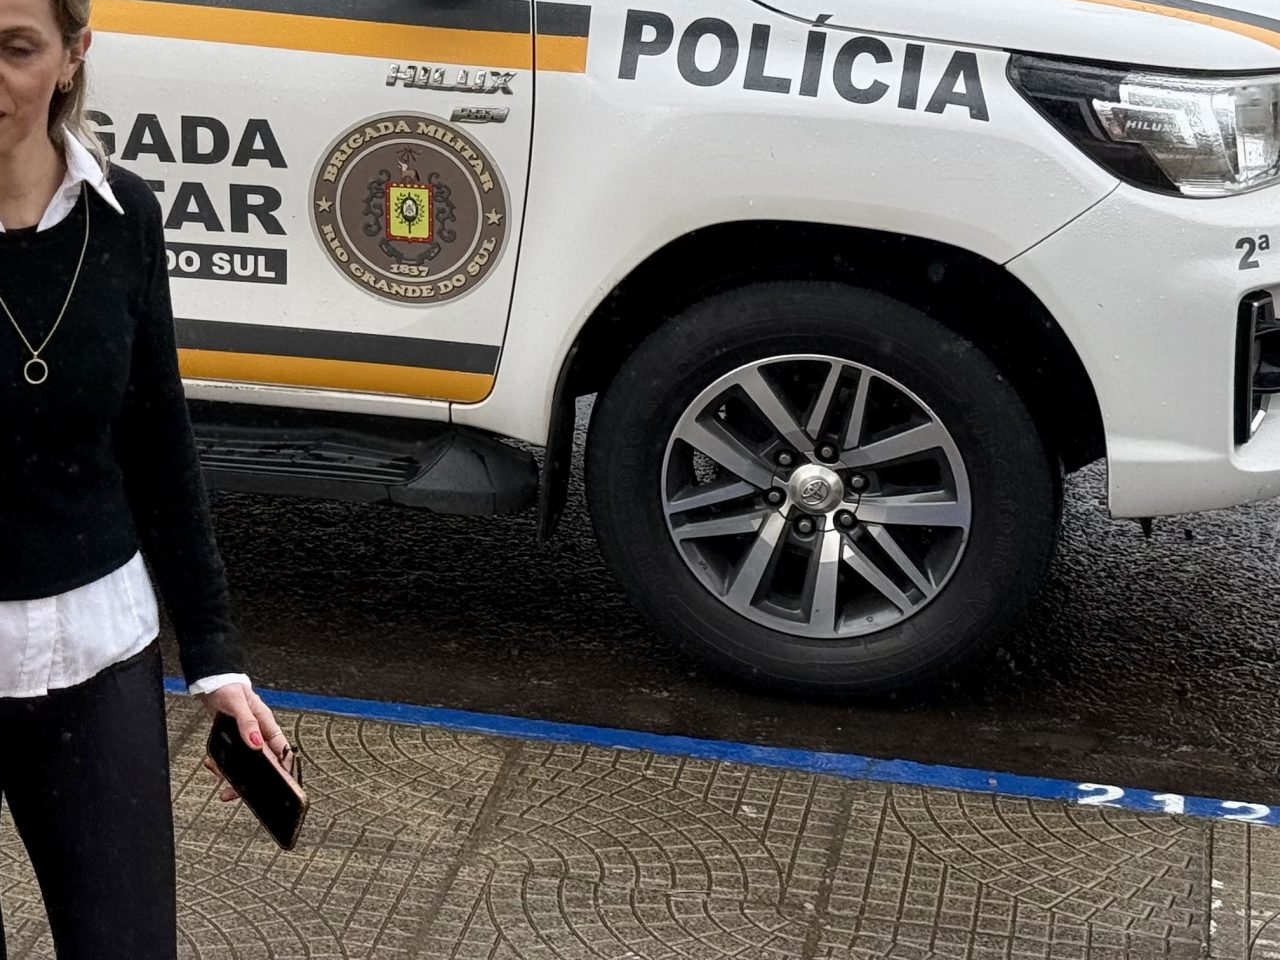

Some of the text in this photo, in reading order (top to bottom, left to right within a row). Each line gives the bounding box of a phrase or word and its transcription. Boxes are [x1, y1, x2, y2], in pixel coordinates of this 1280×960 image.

[386, 63, 518, 95] HILUX
[618, 8, 990, 122] POLÍCIA
[323, 120, 495, 193] BRIGADA MILITAR
[212, 252, 276, 278] SUL
[322, 223, 497, 298] RIO GRANDE DO SUL
[390, 264, 430, 277] 1837
